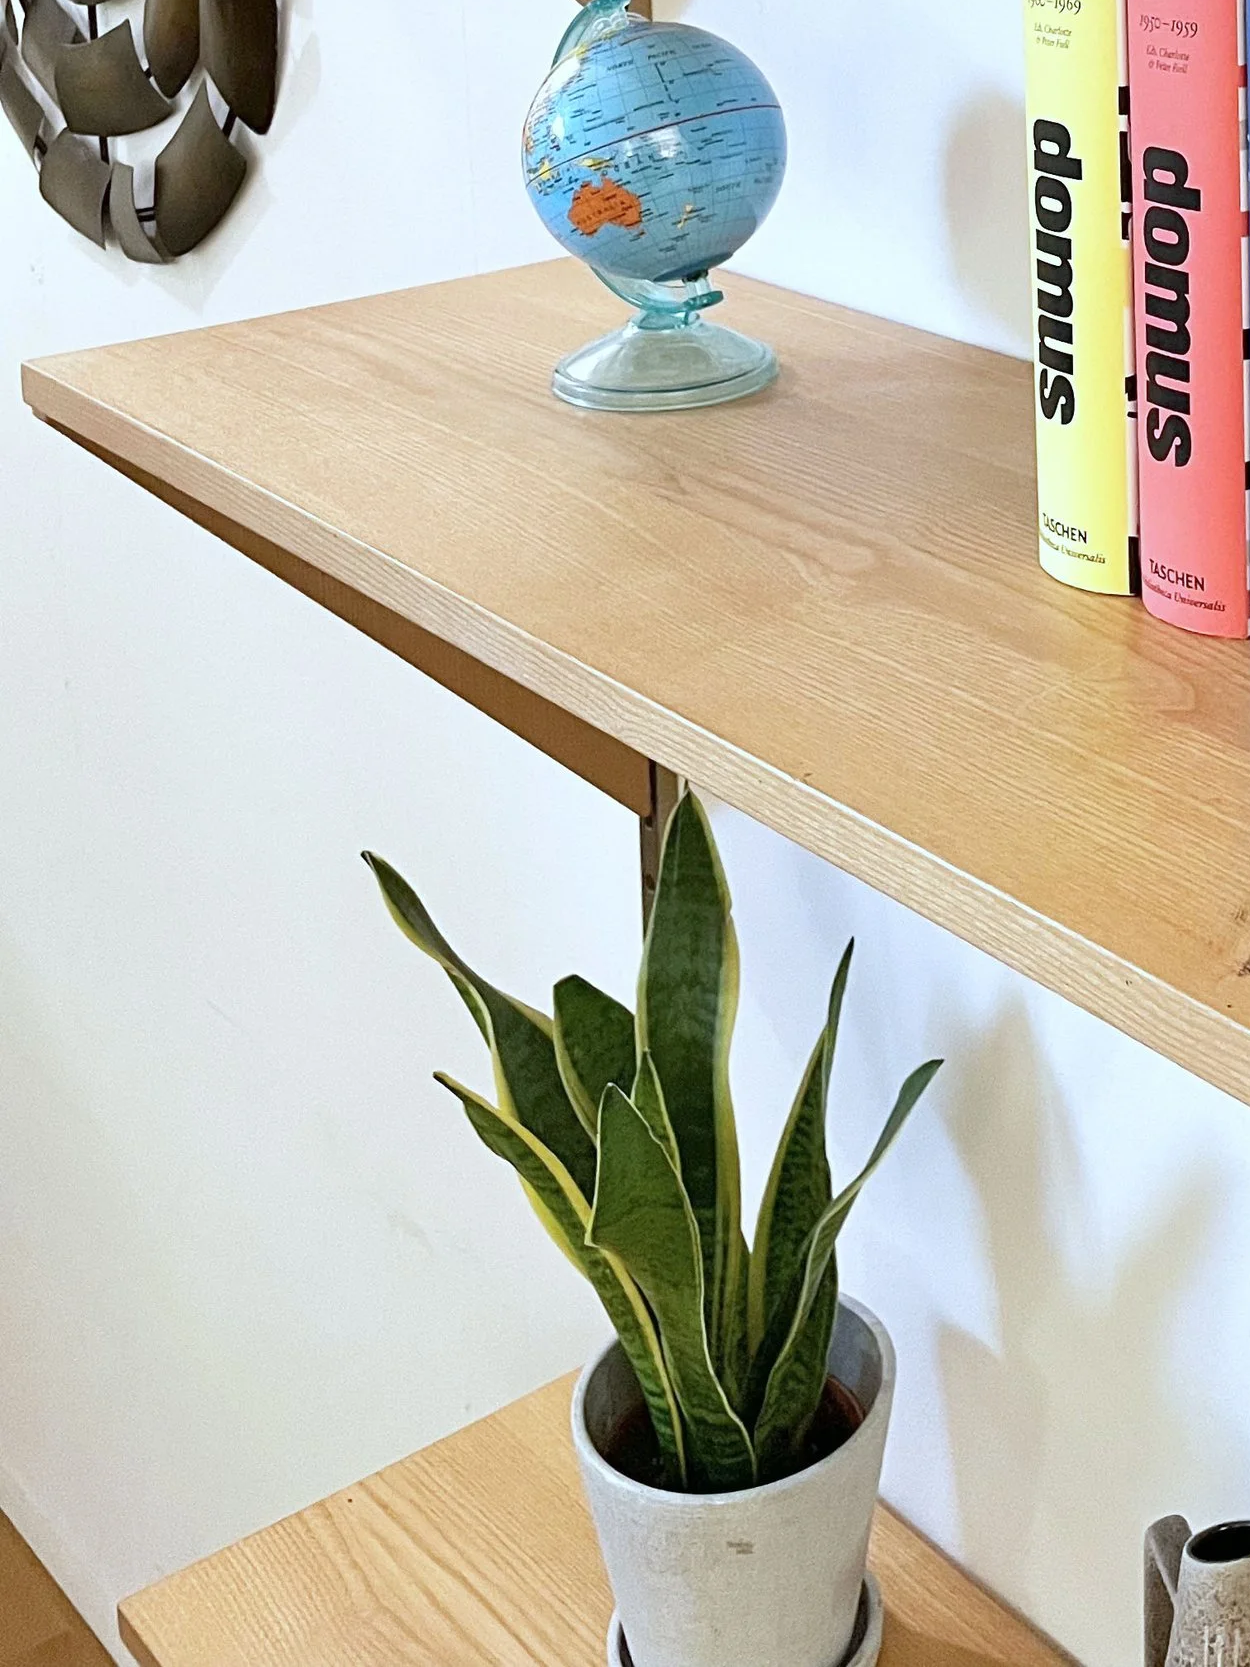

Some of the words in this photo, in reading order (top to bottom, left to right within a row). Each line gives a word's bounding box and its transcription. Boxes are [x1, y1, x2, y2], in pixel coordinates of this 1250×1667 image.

[1033, 118, 1083, 425] domus
[1143, 145, 1202, 468] domus
[1042, 512, 1088, 545] TASCHEN
[1148, 558, 1205, 592] TASCHEN
